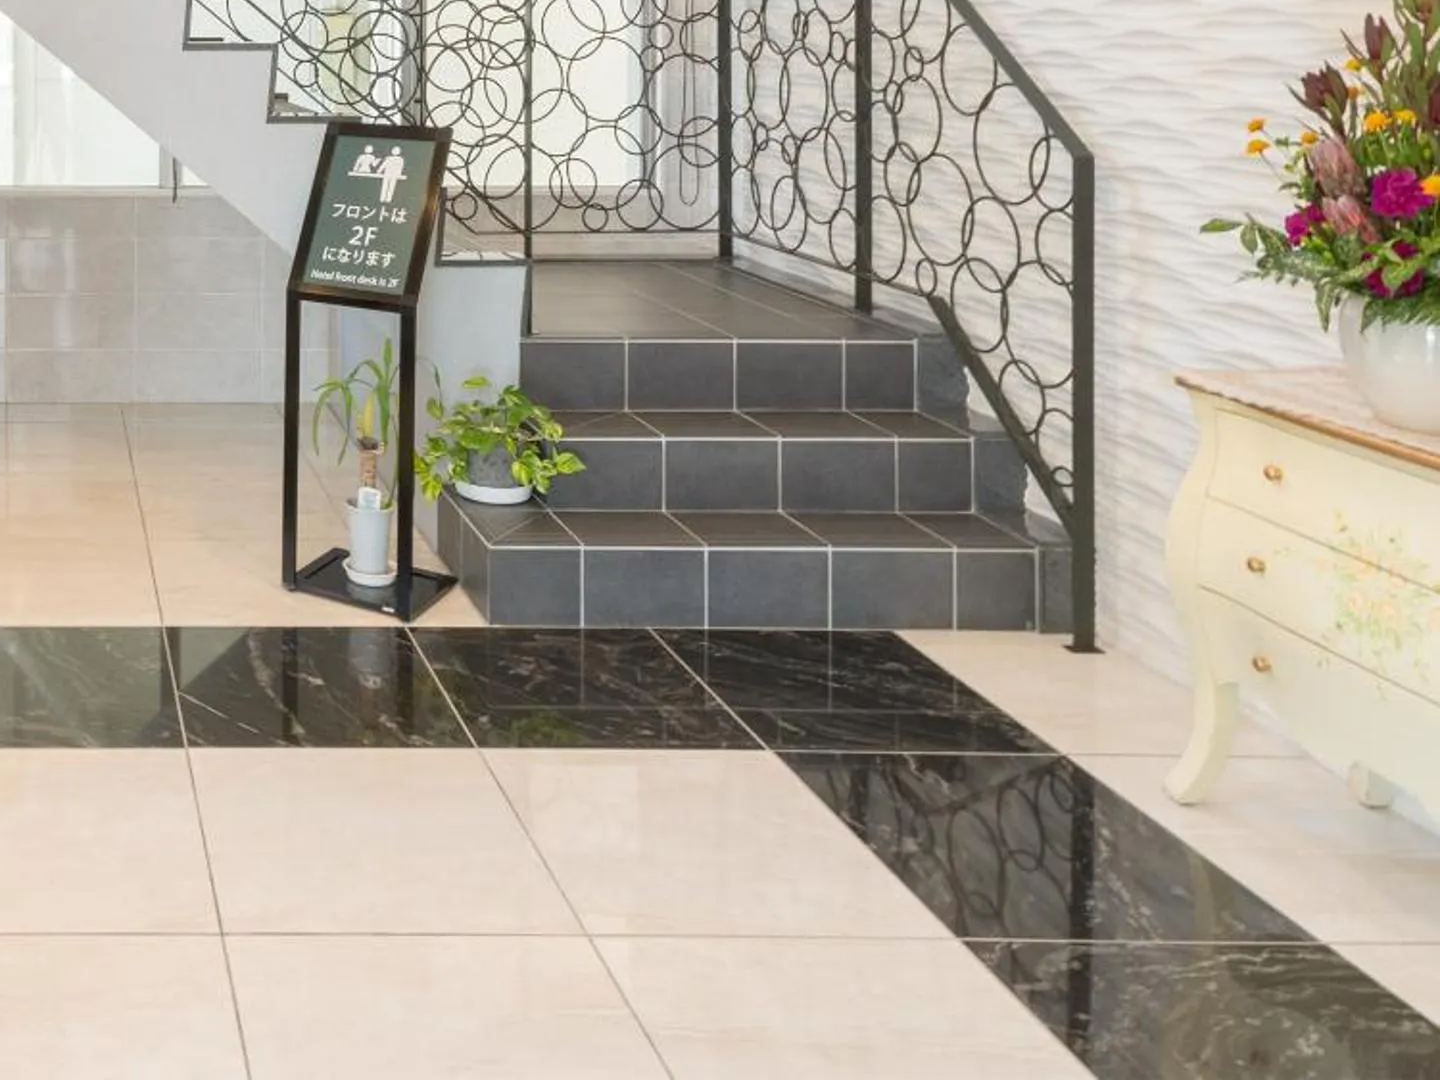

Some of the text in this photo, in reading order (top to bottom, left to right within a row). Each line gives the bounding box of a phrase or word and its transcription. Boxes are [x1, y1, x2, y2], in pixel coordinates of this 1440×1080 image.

[331, 203, 407, 224] フロントは
[348, 225, 379, 247] 2F
[323, 246, 397, 268] になります
[310, 268, 335, 280] Hotel
[335, 271, 356, 284] front
